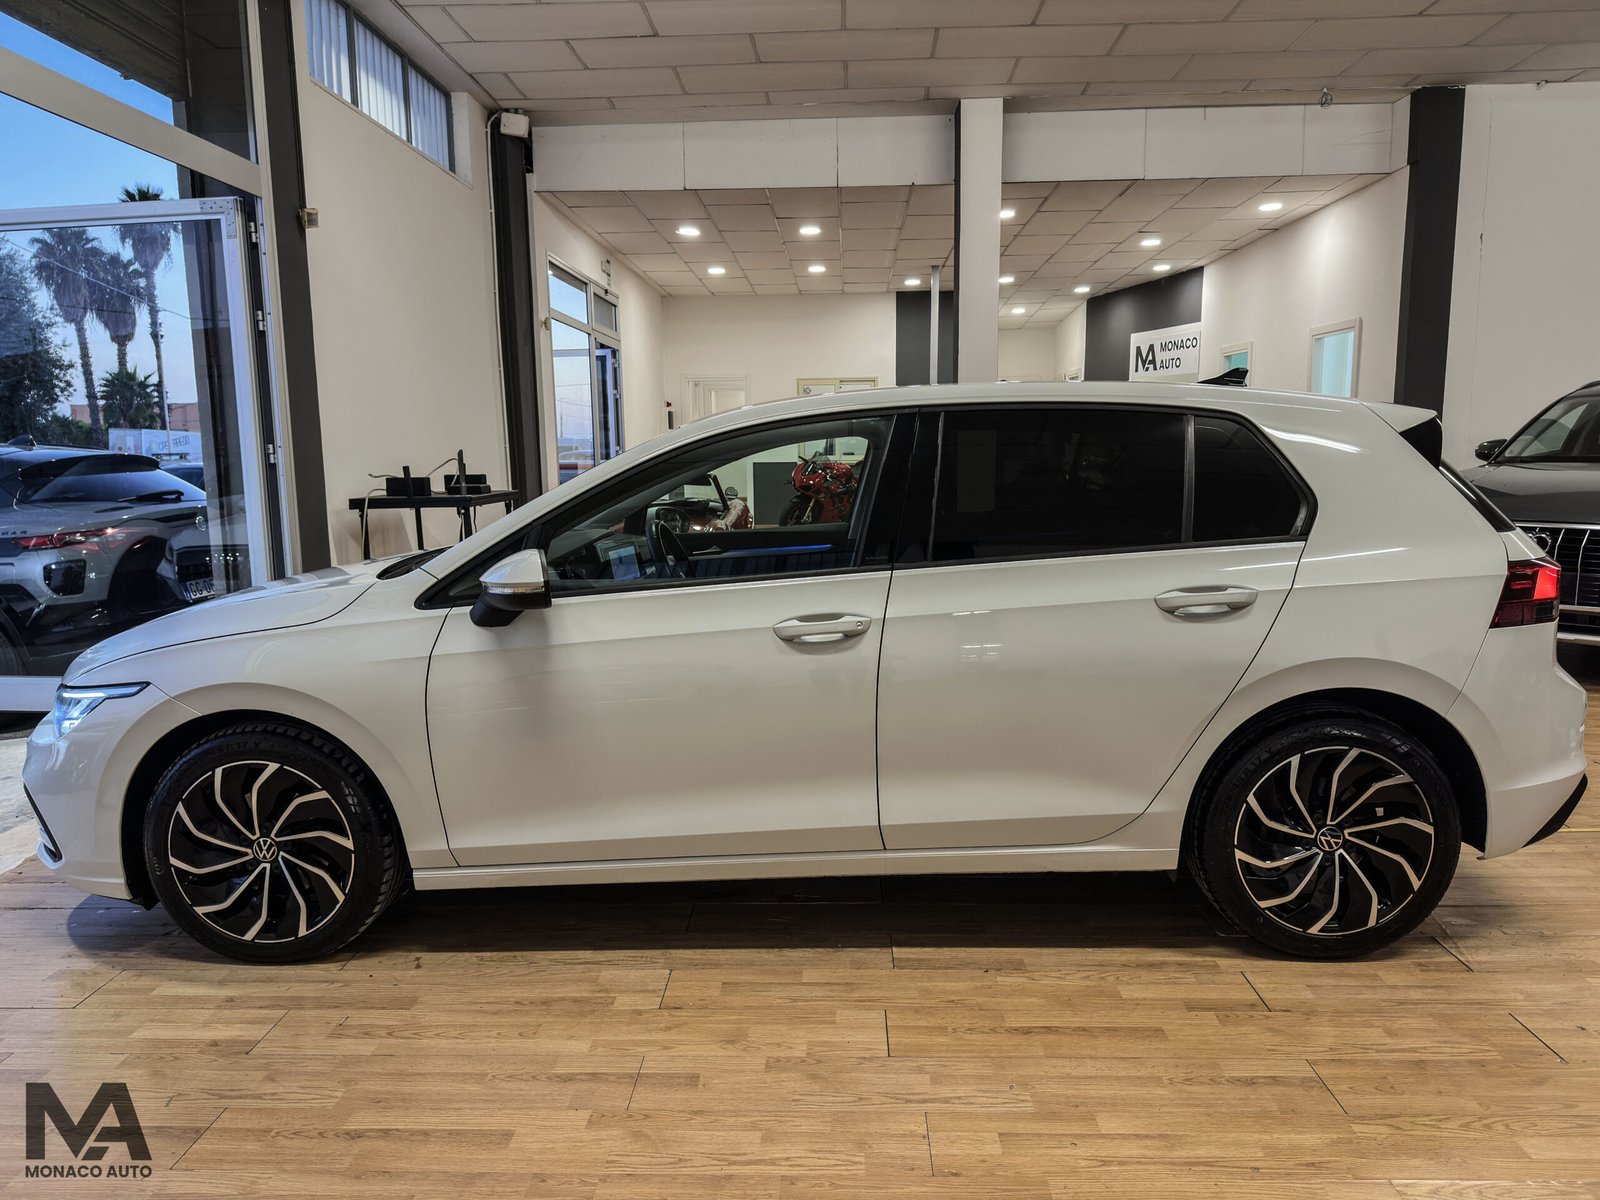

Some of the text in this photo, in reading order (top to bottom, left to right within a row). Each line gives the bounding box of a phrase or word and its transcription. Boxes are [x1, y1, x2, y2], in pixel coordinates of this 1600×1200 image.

[1160, 337, 1198, 352] MONACO
[1135, 343, 1158, 372] MA
[1159, 357, 1182, 370] AUTO
[253, 838, 277, 861] VW
